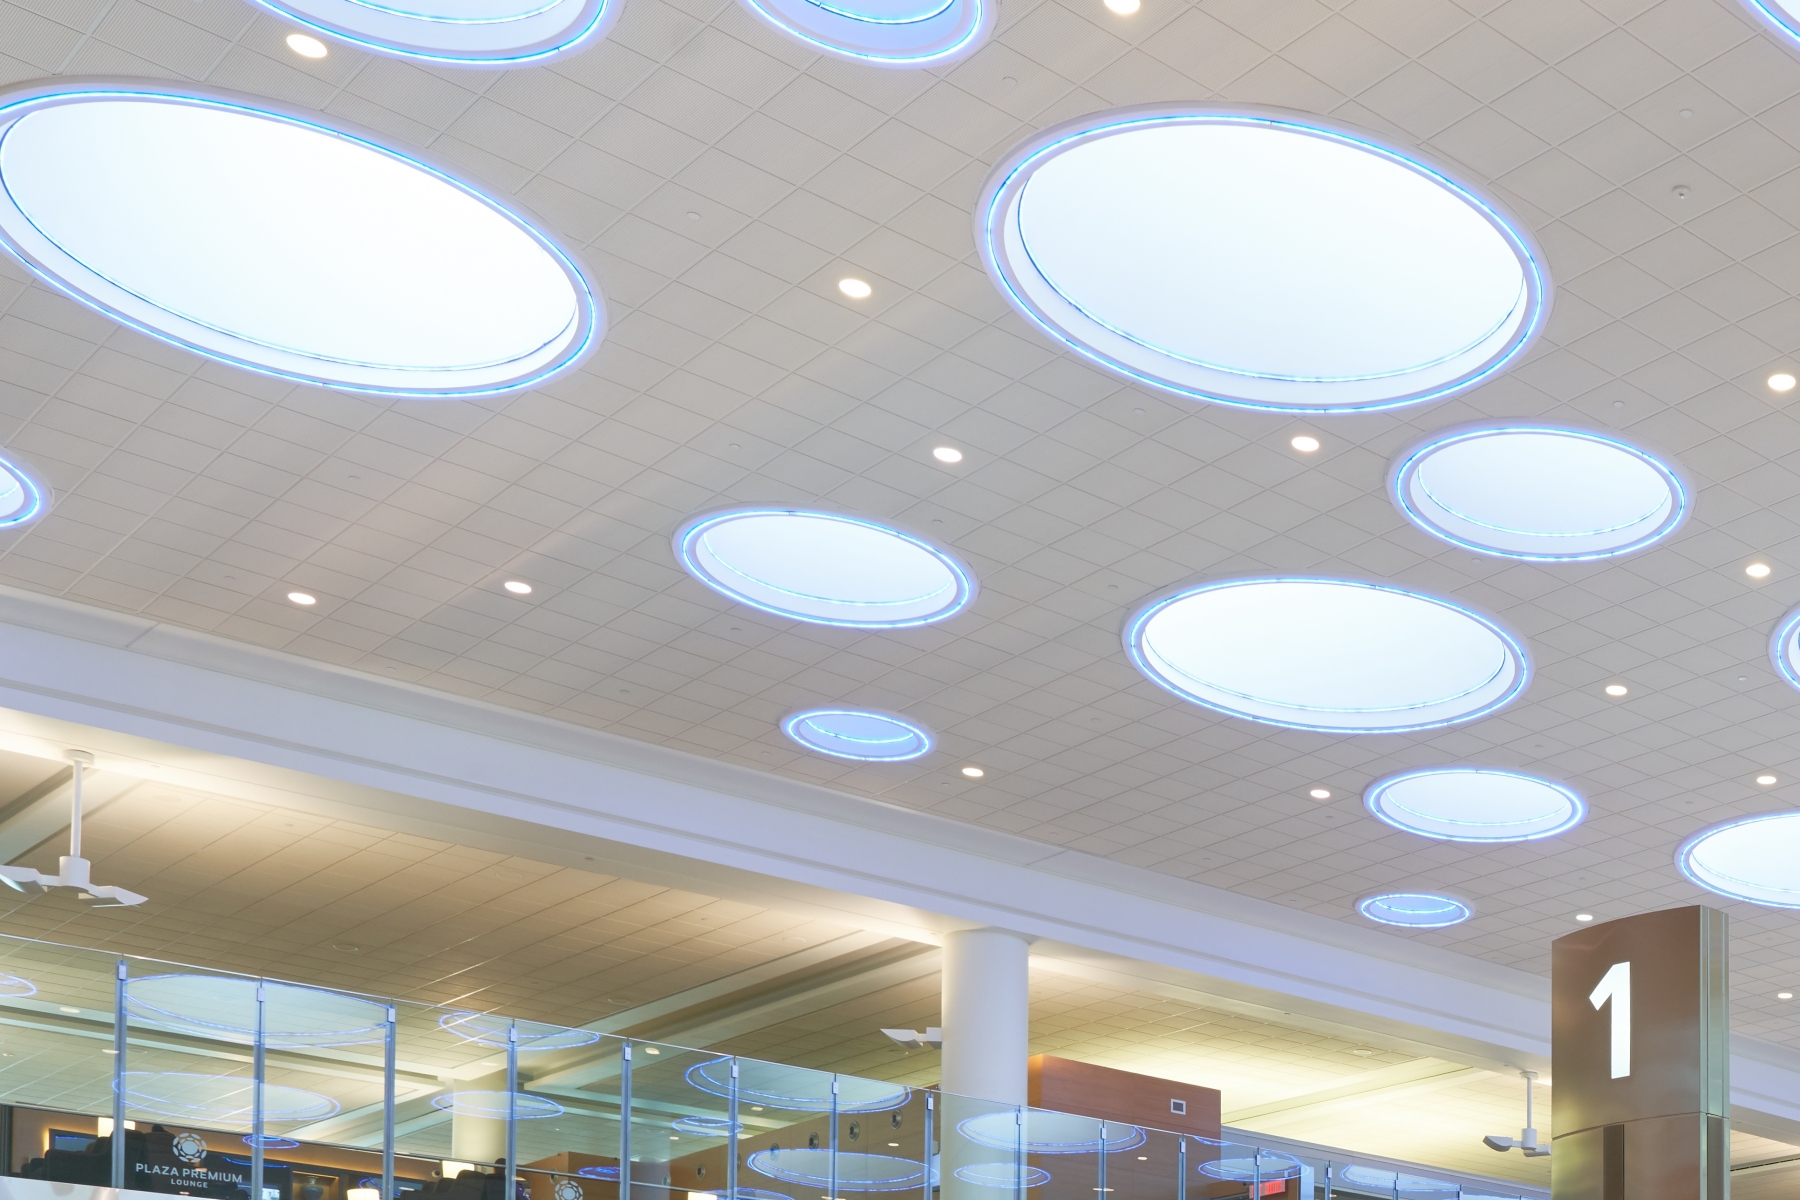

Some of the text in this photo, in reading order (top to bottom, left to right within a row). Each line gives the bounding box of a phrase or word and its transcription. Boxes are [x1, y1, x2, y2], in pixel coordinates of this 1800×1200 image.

[1589, 961, 1630, 1079] 1
[136, 1163, 242, 1183] PLAZA PREMIUM
[171, 1178, 208, 1188] LOUNGE
